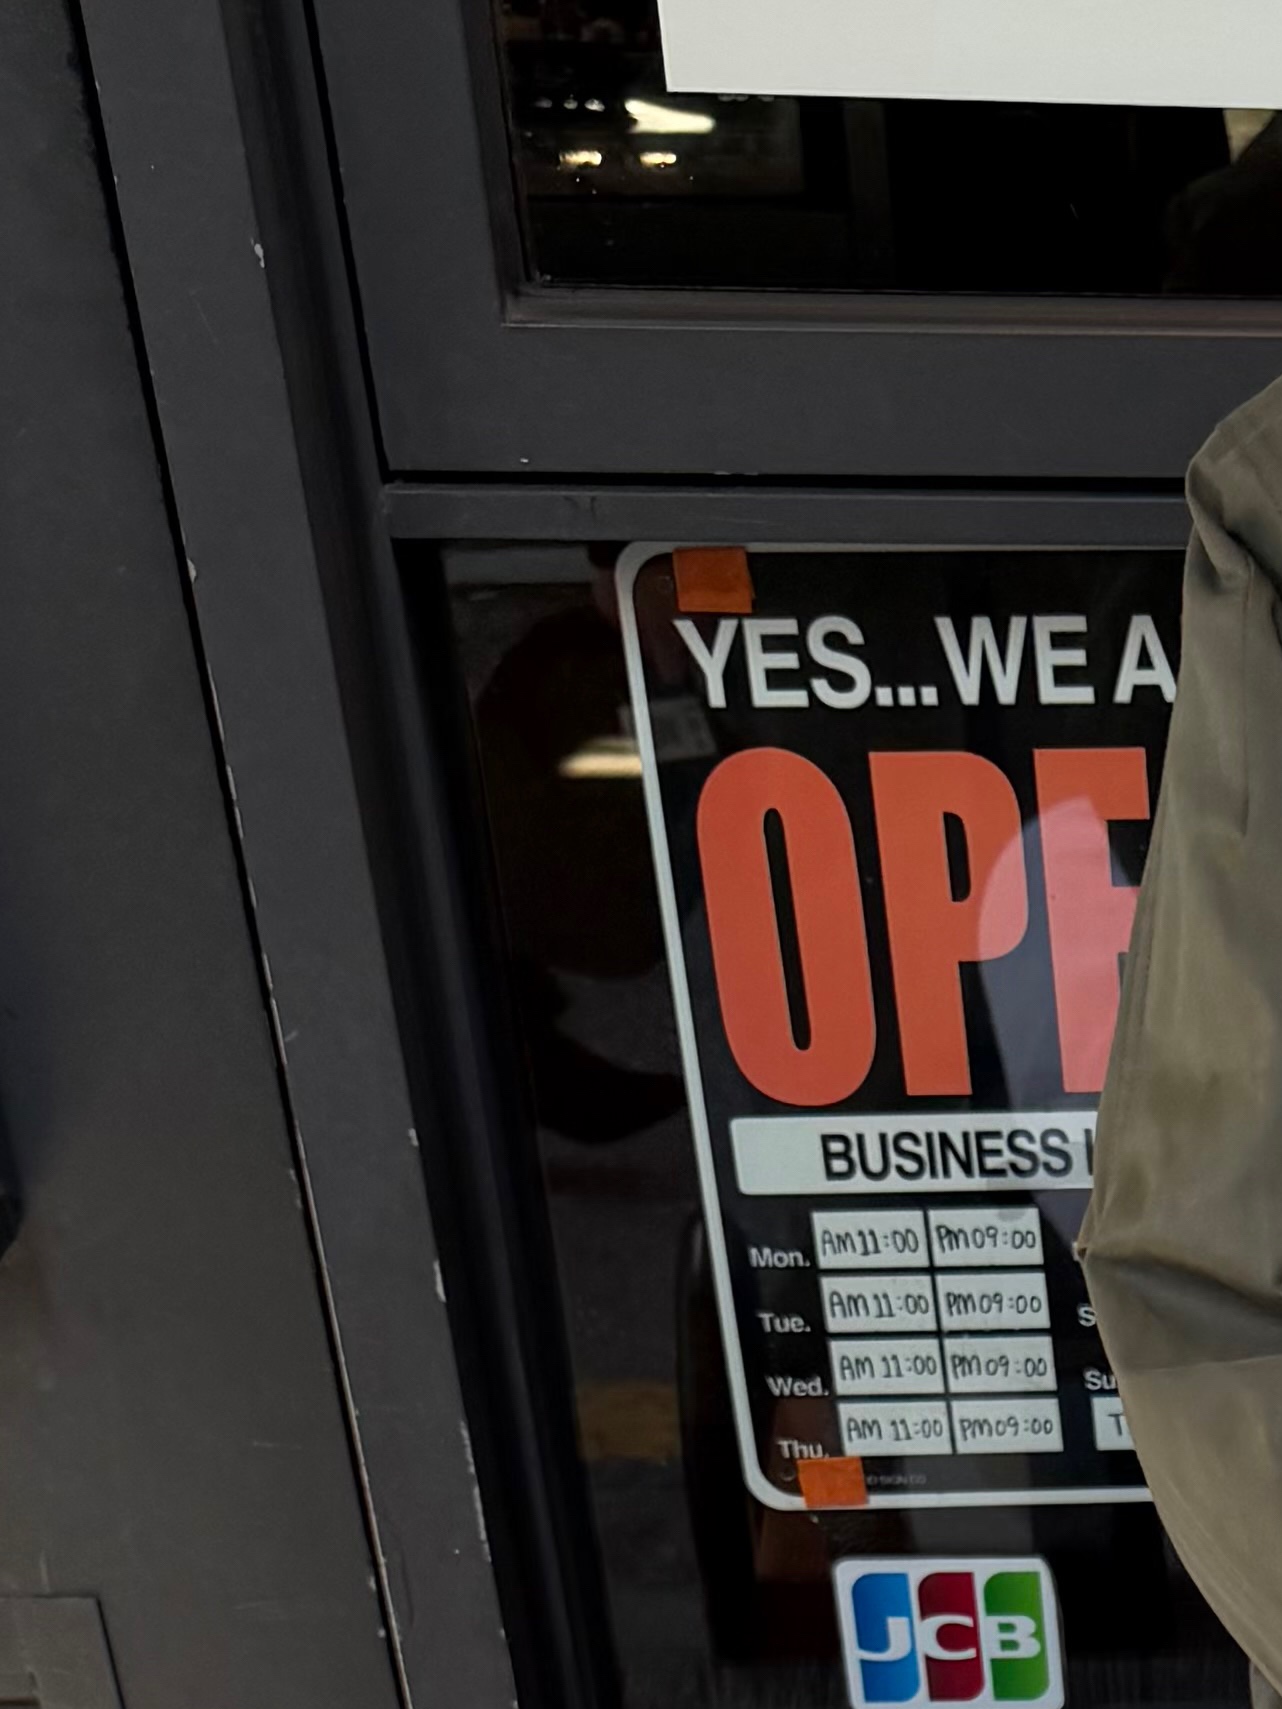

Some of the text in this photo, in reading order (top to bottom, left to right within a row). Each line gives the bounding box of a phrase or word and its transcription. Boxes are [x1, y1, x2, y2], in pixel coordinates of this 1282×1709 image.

[820, 1128, 1073, 1181] BUSINESS
[750, 1246, 811, 1269] Mon.
[757, 1312, 812, 1333] Tue.
[765, 1375, 830, 1397] Wed.
[777, 1439, 830, 1460] Thu.
[857, 1613, 1042, 1662] JCB
